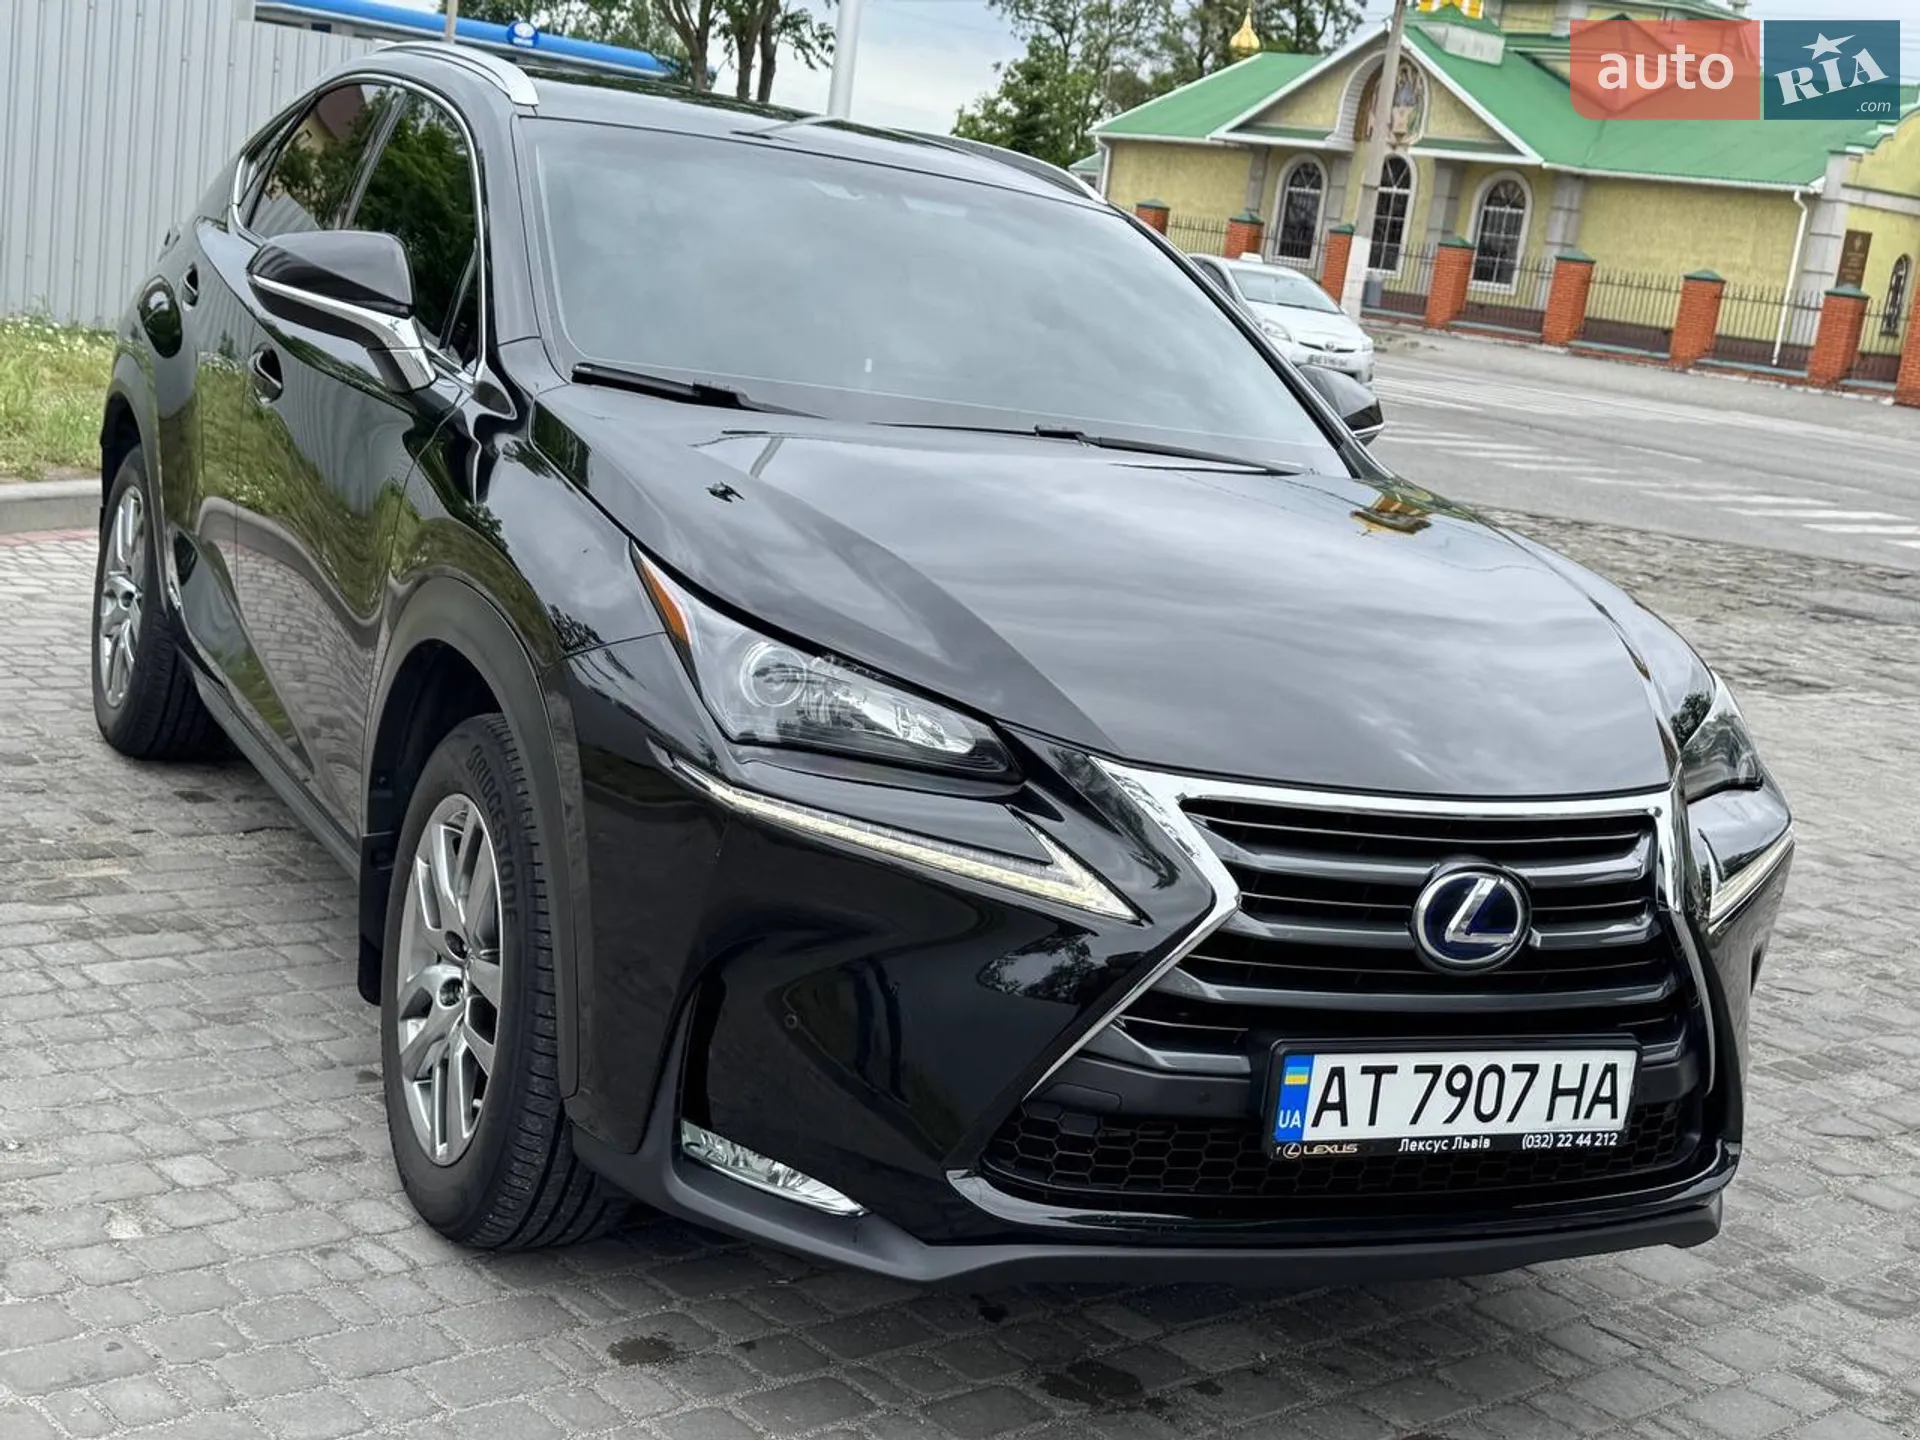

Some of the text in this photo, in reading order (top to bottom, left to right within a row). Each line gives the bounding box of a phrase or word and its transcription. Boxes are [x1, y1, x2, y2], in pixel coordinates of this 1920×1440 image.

[466, 744, 518, 926] BRIDGESTONE
[1311, 1062, 1619, 1128] AT 7907 HA
[1278, 1110, 1302, 1129] UA
[1303, 1144, 1358, 1155] LEXUS
[1398, 1135, 1491, 1153] Лексус Львів
[1522, 1132, 1618, 1150] (032) 22 44 212
